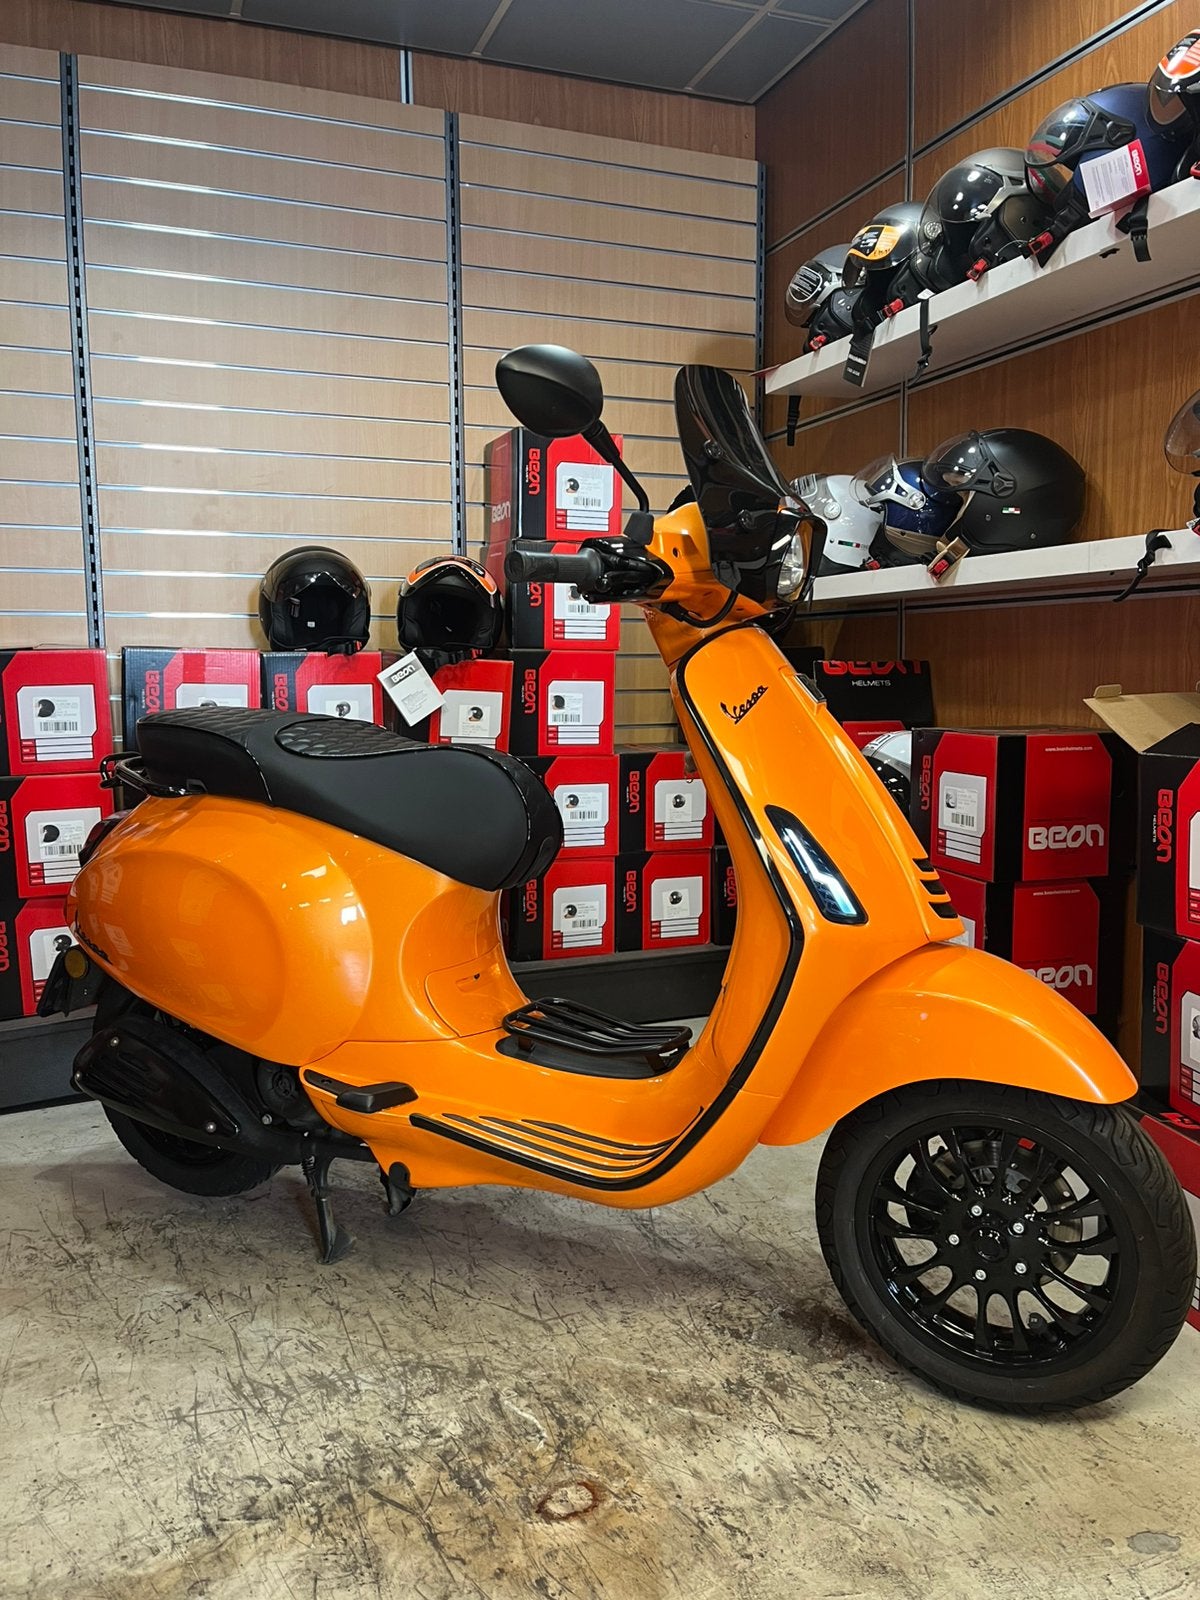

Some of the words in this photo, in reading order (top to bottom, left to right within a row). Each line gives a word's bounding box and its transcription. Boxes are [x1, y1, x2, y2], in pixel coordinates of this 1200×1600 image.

[530, 582, 541, 607] on
[145, 671, 160, 714] Beo
[274, 673, 289, 712] Beo
[720, 685, 768, 725] Vespa
